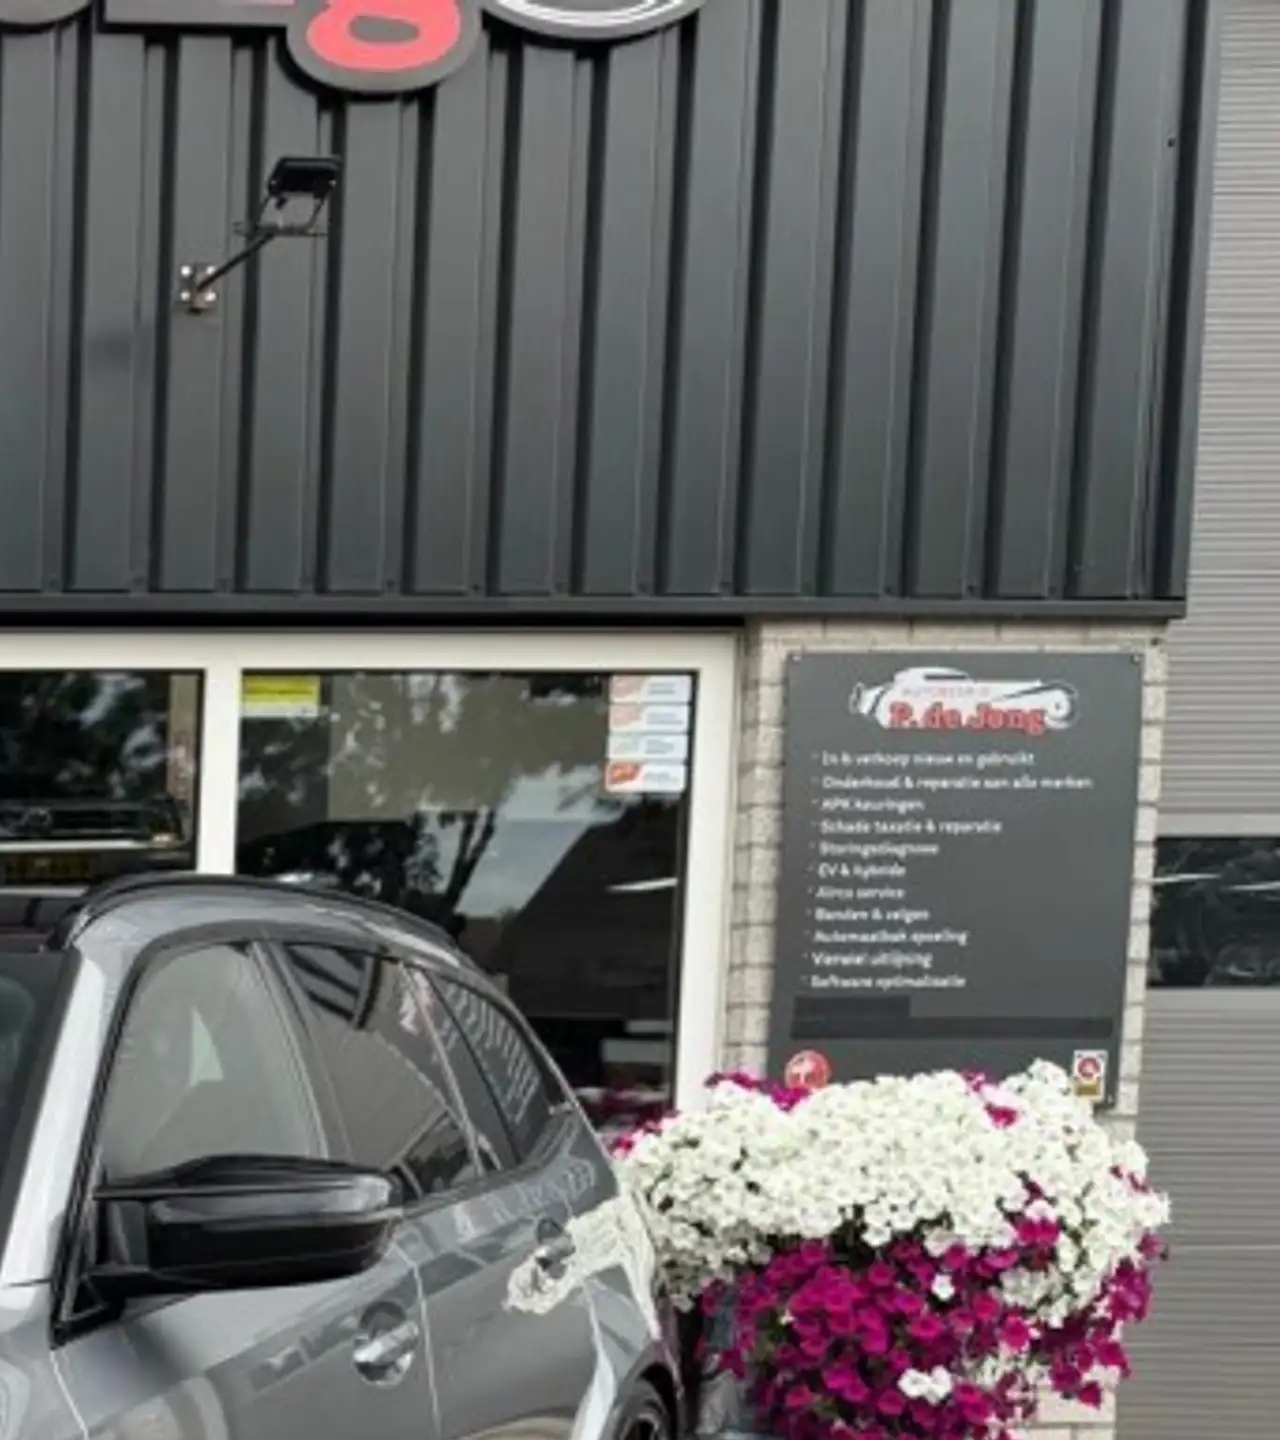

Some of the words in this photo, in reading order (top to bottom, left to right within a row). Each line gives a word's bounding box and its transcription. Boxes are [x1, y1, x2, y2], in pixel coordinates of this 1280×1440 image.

[890, 701, 918, 728] P.
[923, 702, 962, 728] de
[967, 703, 1047, 734] Jong
